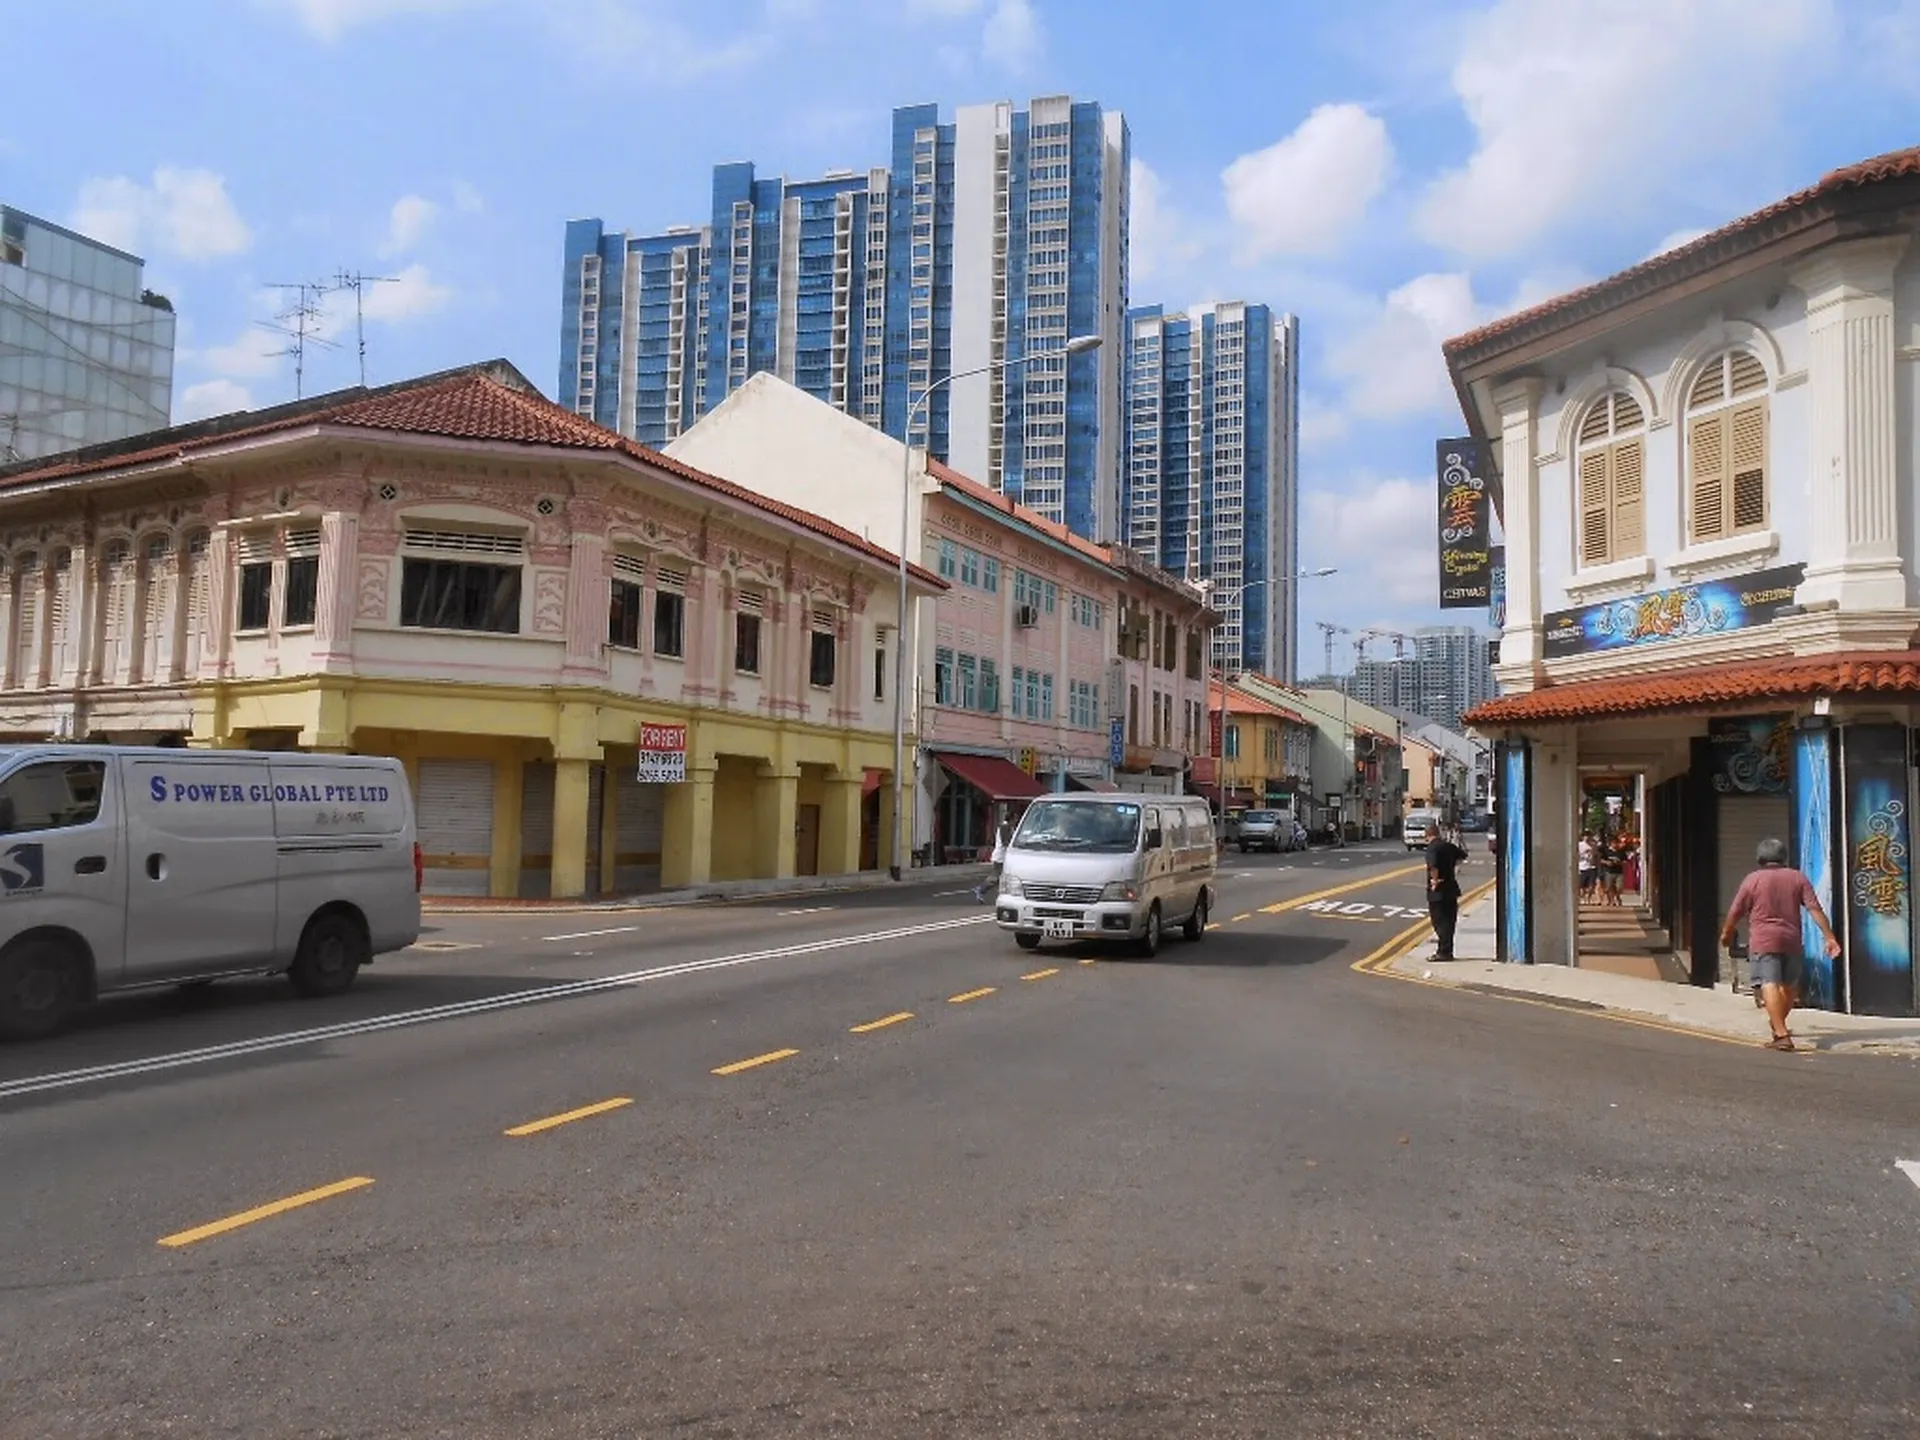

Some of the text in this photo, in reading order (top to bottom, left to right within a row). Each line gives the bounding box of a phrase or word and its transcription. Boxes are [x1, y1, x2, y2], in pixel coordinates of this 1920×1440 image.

[150, 775, 389, 802] S POWER GLOBAL PTE LTD
